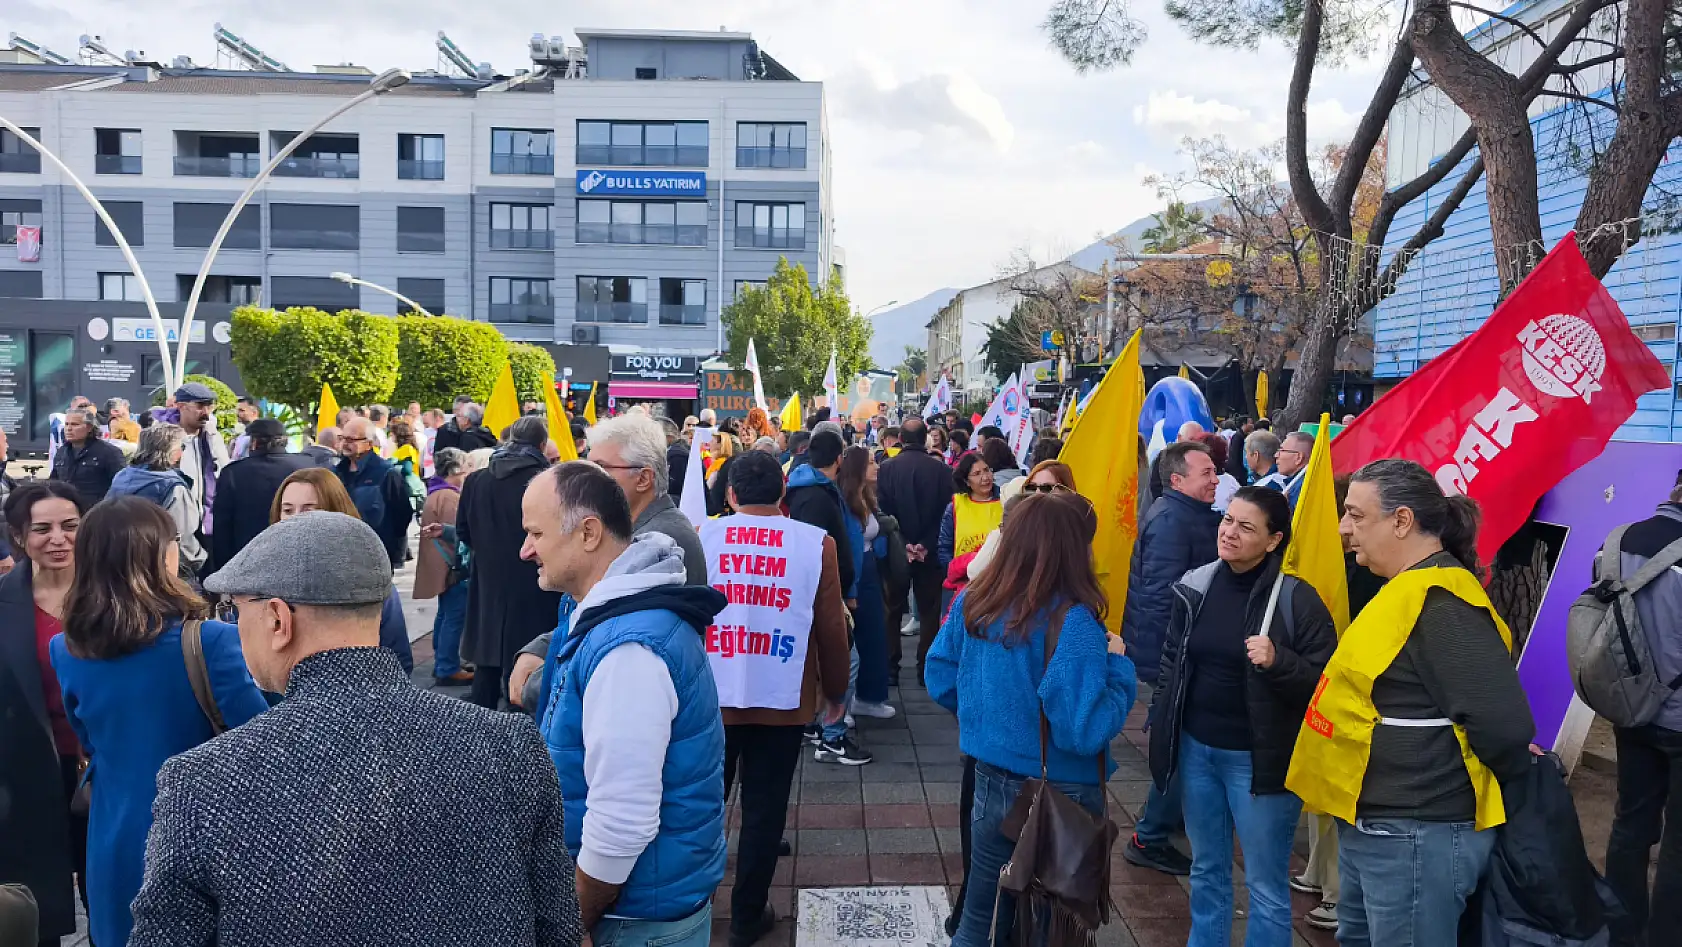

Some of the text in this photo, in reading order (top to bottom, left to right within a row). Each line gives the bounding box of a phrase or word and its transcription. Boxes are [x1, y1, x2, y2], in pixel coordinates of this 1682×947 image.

[606, 177, 700, 190] BULLS YATIRIM
[135, 328, 177, 341] GEA
[625, 355, 682, 369] FOR YOU
[1515, 318, 1603, 405] KESK
[1529, 367, 1557, 390] 1995
[706, 395, 781, 411] BURGR
[724, 526, 784, 548] EMEK
[719, 553, 787, 578] EYLEM
[704, 624, 796, 663] Eğitmiş
[866, 889, 910, 897] SCAN
